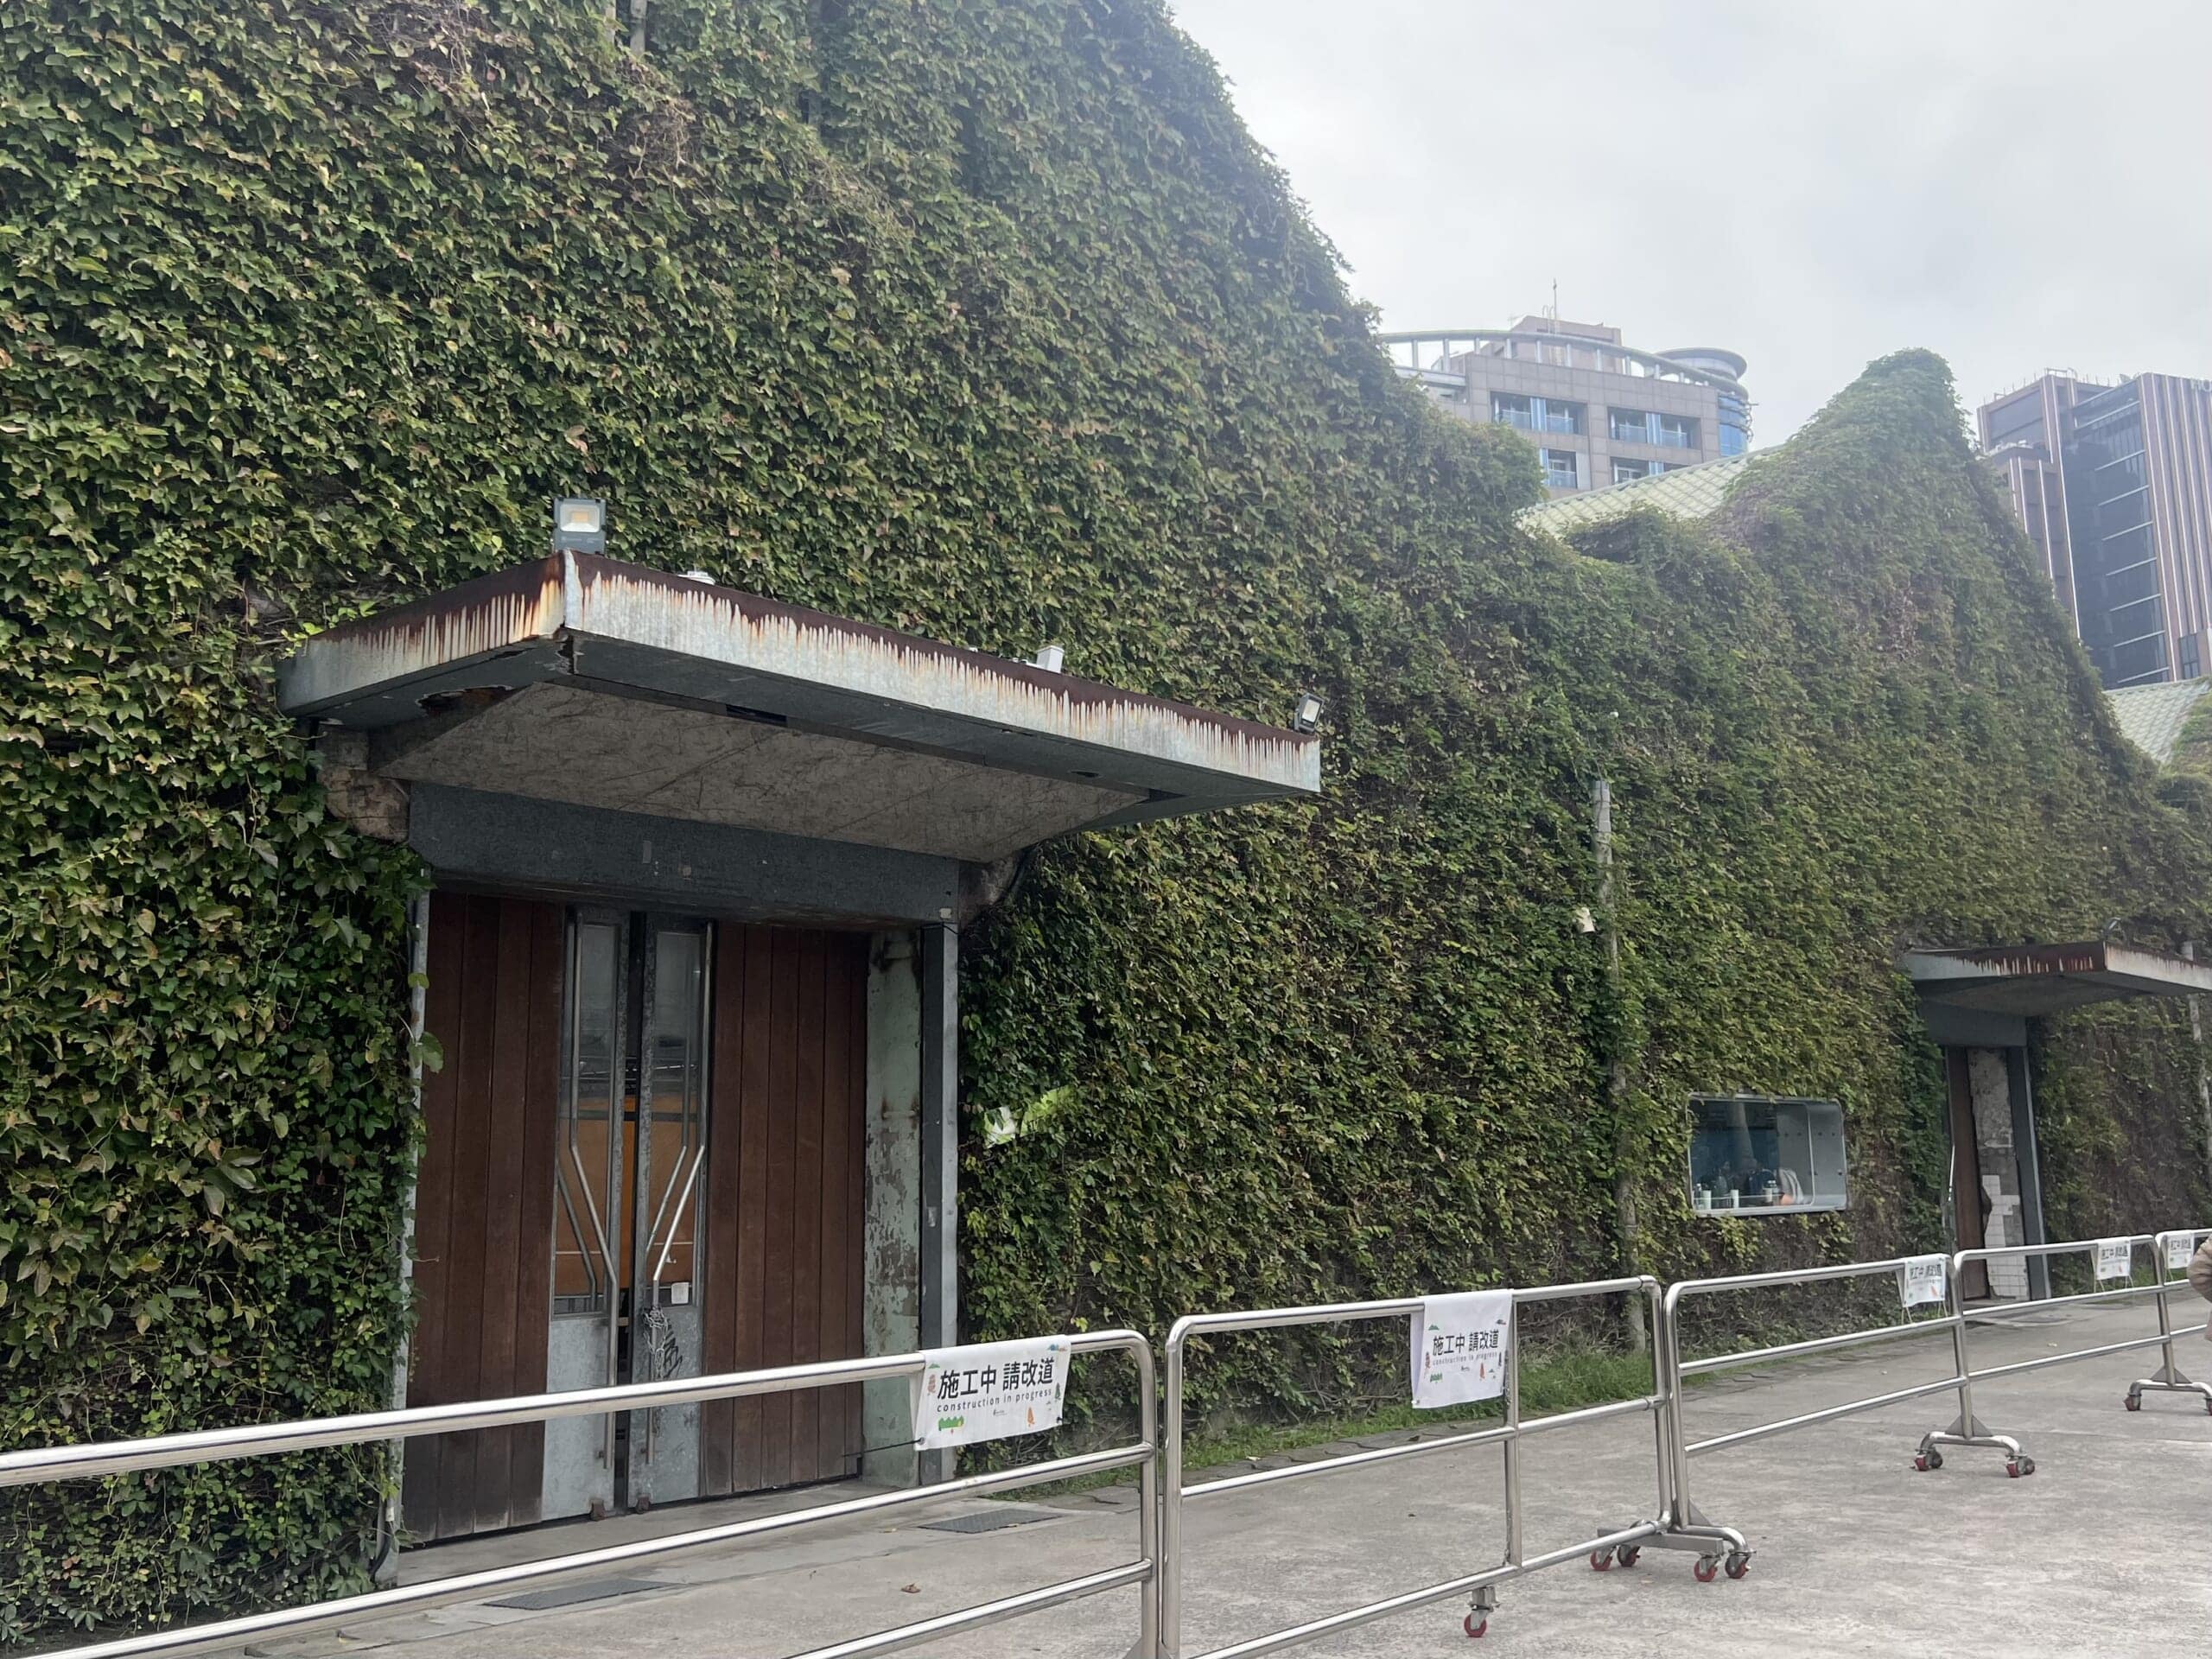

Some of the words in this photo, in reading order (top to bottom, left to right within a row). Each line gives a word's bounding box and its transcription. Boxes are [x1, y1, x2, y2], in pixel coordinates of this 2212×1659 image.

[1433, 1332, 1465, 1356] 施工中
[1469, 1329, 1499, 1351] 請改道
[938, 1365, 997, 1400] 施工中
[1002, 1357, 1055, 1391] 請改道
[937, 1396, 1000, 1412] construction
[1015, 1389, 1052, 1403] progress
